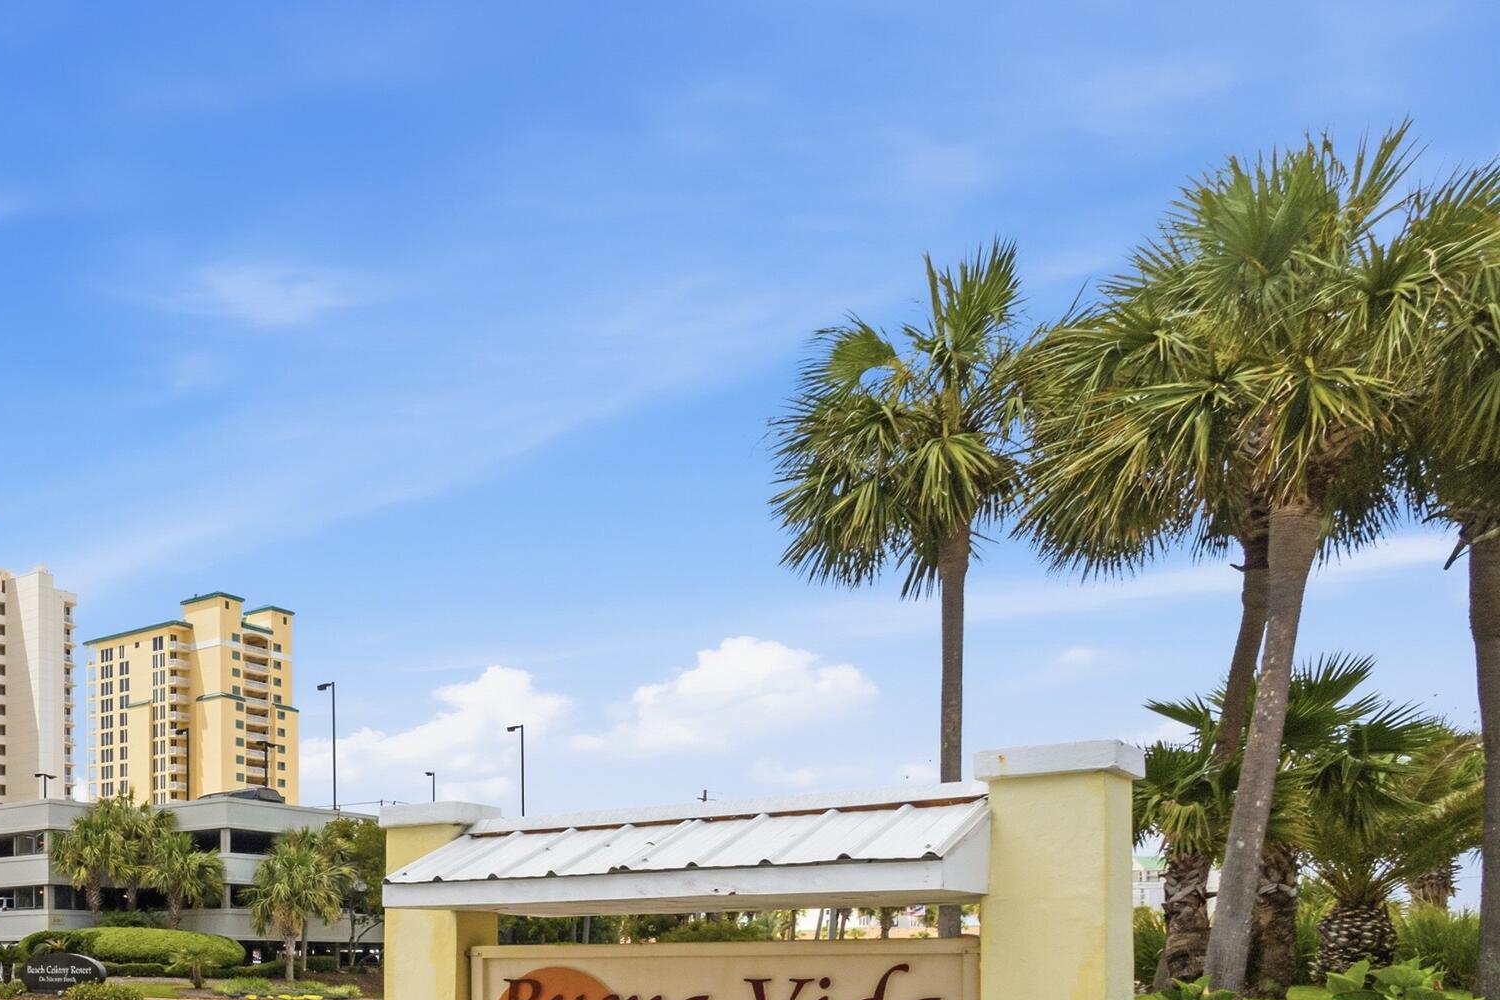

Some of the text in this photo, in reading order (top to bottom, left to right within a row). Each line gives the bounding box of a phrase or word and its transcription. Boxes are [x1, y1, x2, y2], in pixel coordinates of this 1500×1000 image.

[26, 965, 92, 976] Beach Colony Resort
